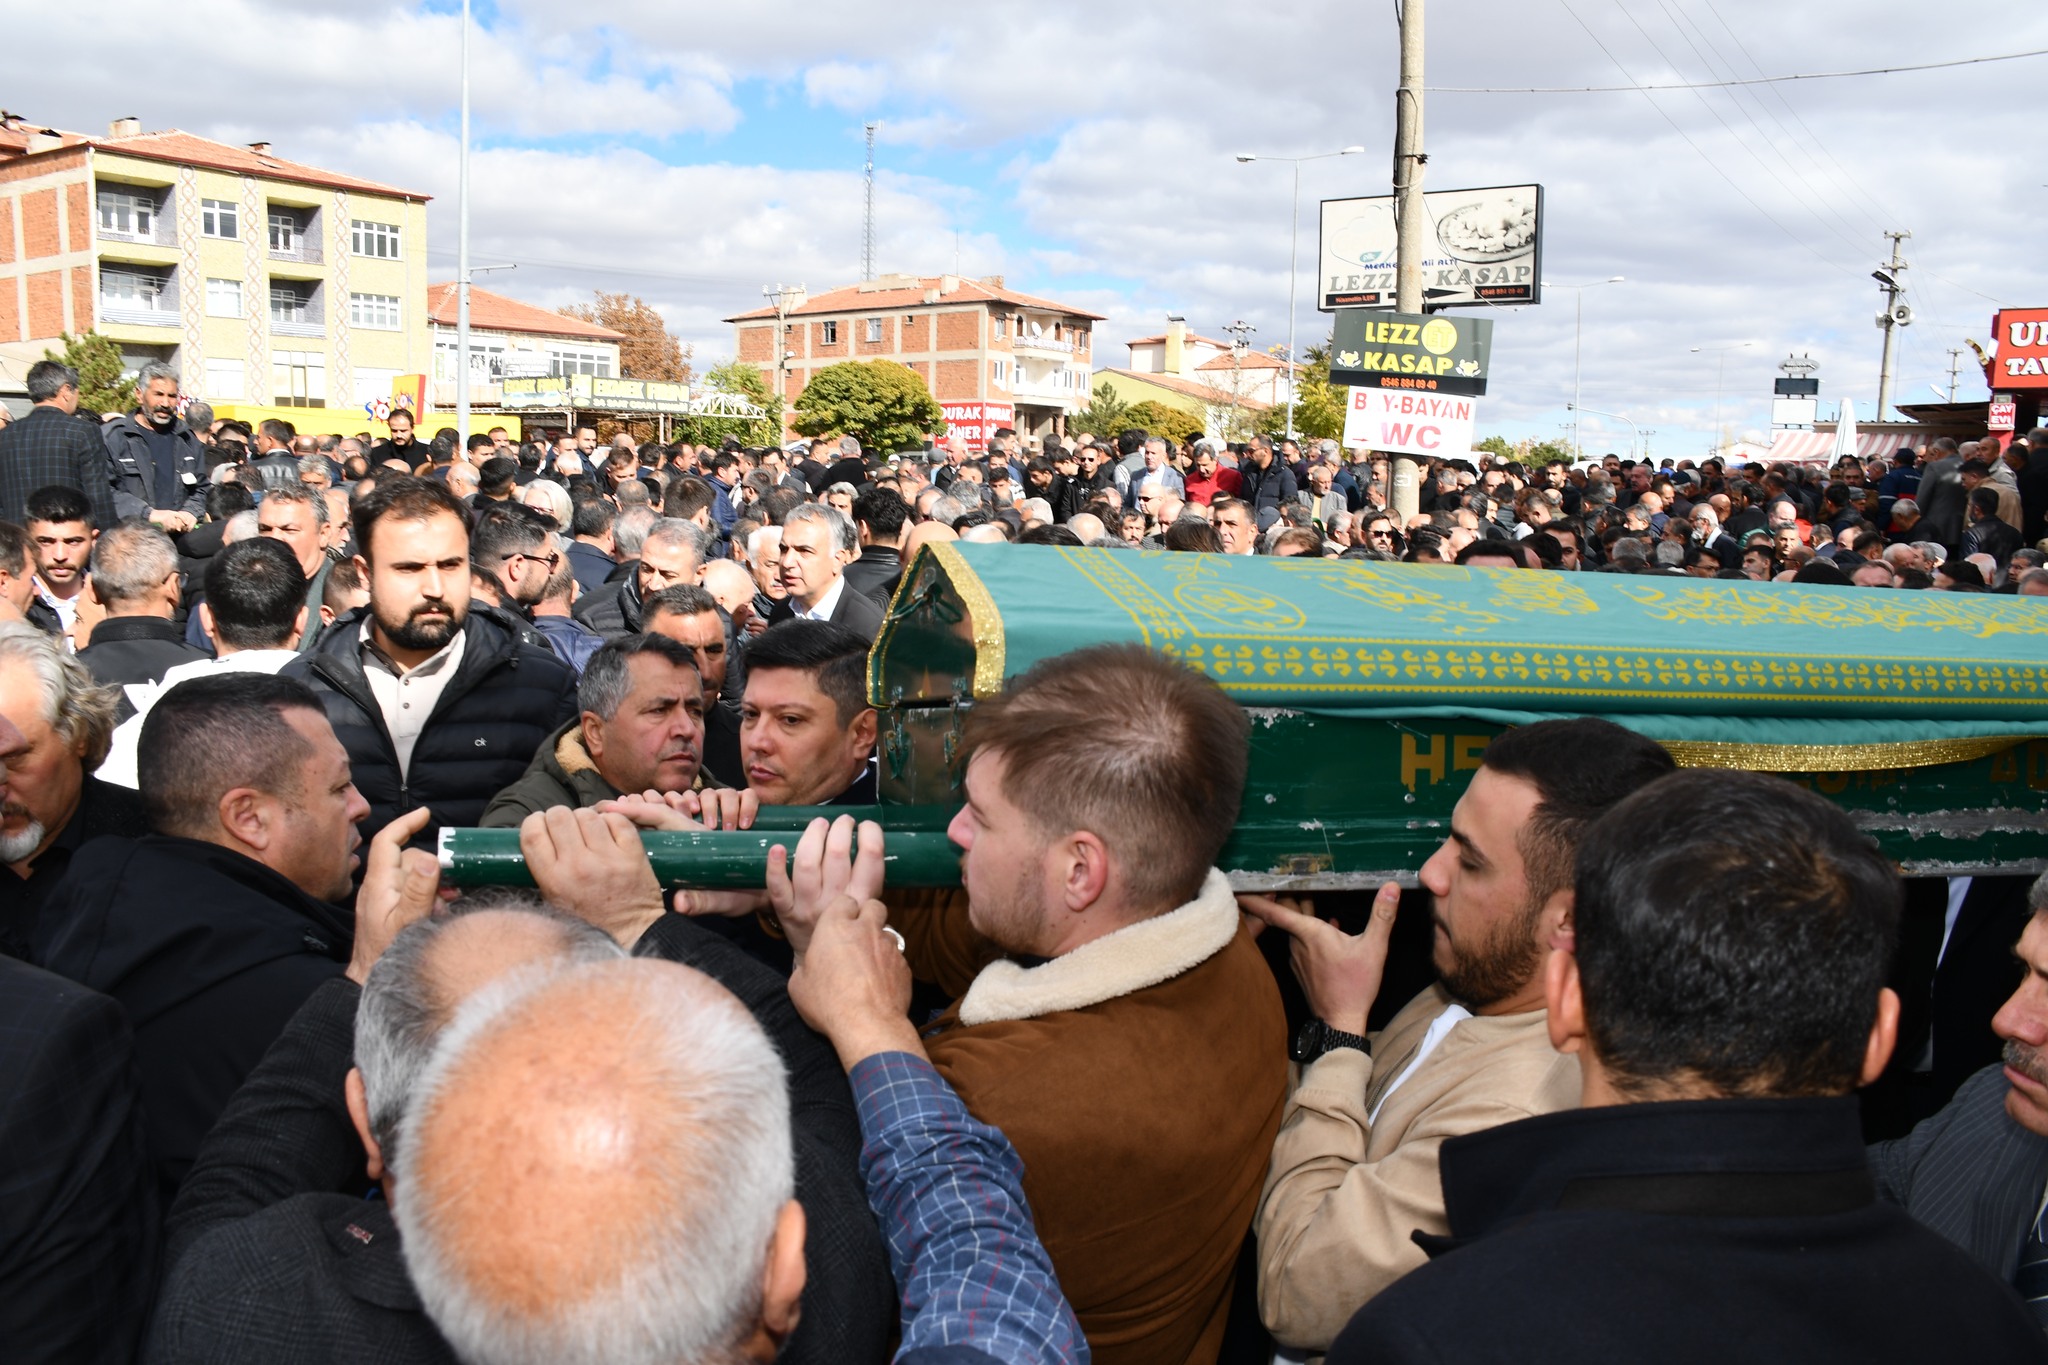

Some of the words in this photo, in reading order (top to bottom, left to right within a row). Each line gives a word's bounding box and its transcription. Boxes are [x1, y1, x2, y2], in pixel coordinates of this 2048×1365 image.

[1435, 266, 1531, 287] KASAP
[1363, 351, 1454, 376] KASAP
[941, 406, 982, 421] DURAK
[985, 406, 1012, 422] DURAK
[1991, 404, 2014, 415] ÇAY
[937, 422, 981, 440] ÖNER
[1381, 421, 1442, 449] WC
